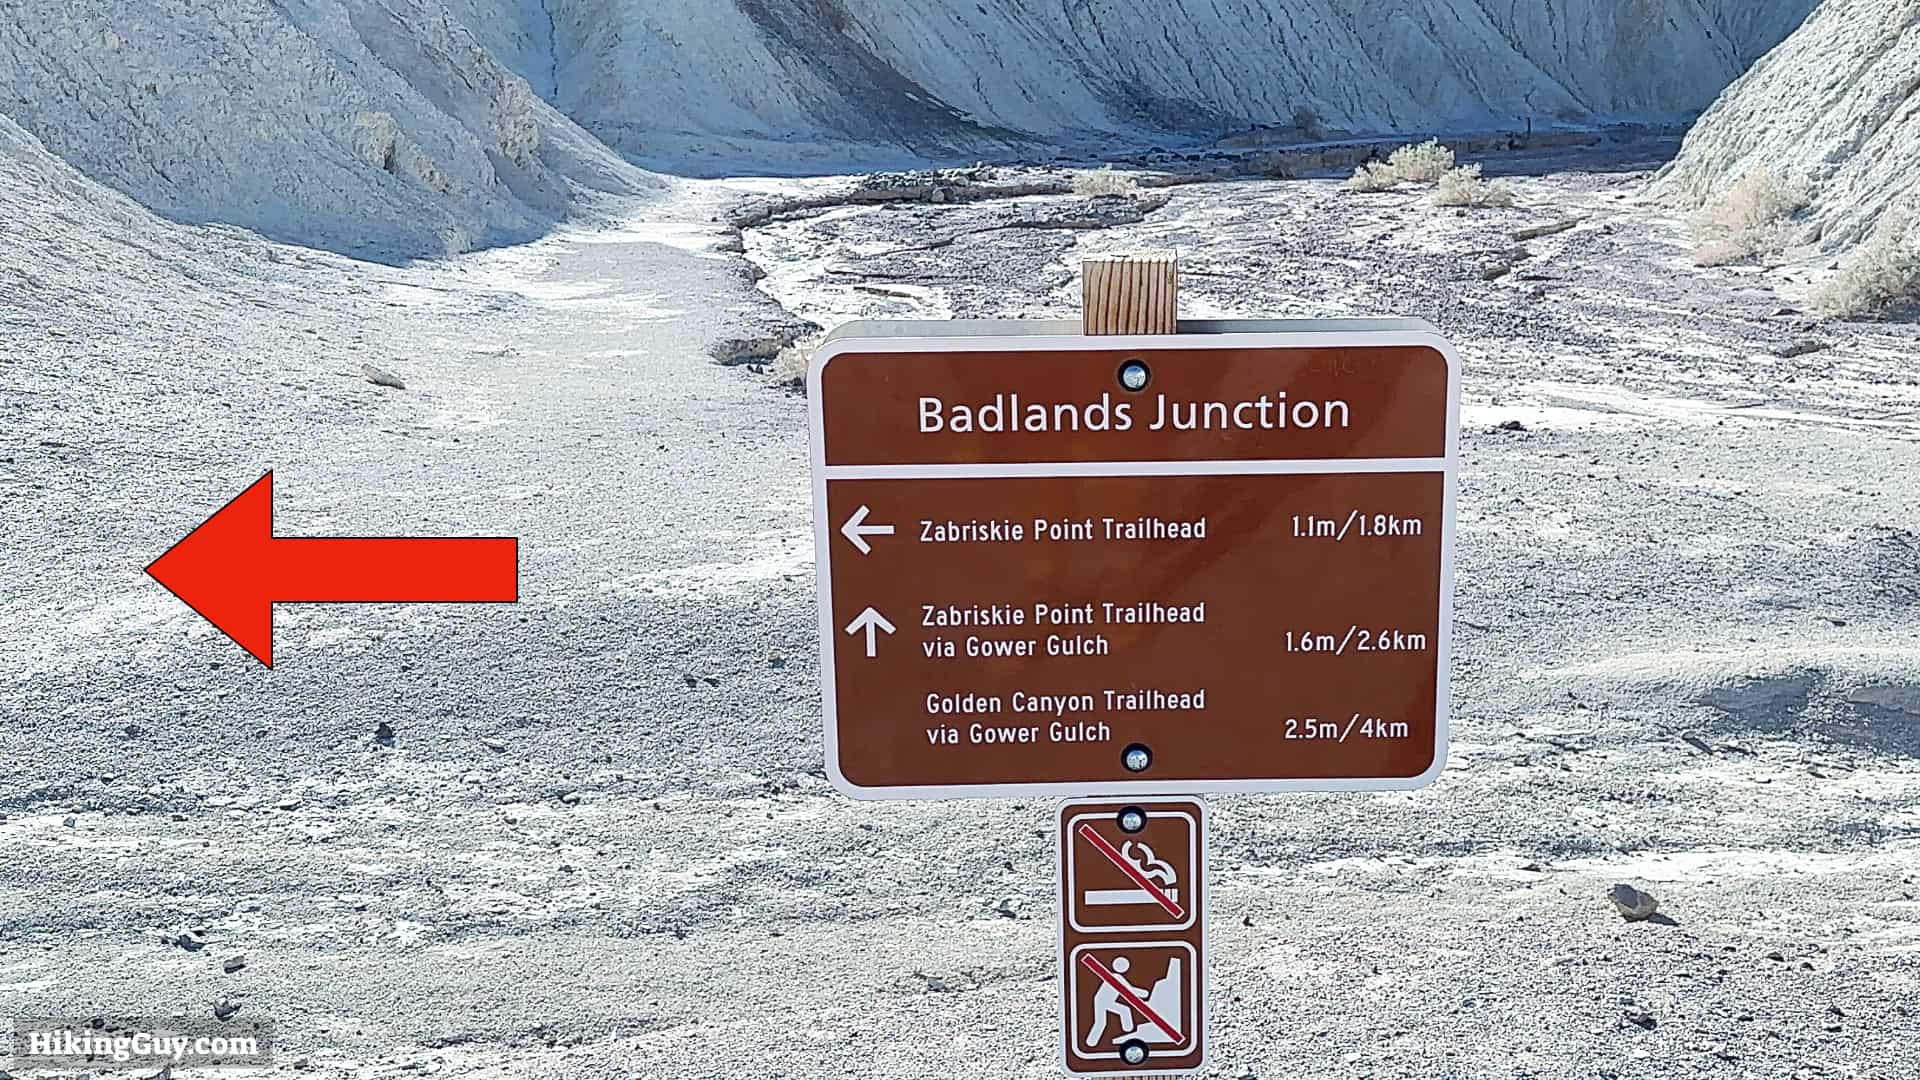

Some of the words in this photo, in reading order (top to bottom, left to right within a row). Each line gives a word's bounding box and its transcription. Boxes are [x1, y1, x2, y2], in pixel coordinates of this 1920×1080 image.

[920, 393, 1131, 432] Badlands
[1149, 392, 1349, 430] Junction
[920, 519, 1024, 542] Zabriskie
[1034, 518, 1093, 541] Point
[1102, 517, 1206, 540] Trailhead
[1292, 510, 1422, 541] 1.1m/1.8km
[922, 604, 1025, 626] Zabriskie
[1035, 603, 1094, 625] Point
[1102, 601, 1205, 624] Trailhead
[922, 636, 955, 658] via
[966, 636, 1037, 657] Gower
[1047, 634, 1108, 656] Gulch
[1286, 625, 1426, 656] 1.6m/2.6km
[926, 692, 1001, 714] Golden
[1012, 691, 1094, 717] Canyon
[1103, 688, 1205, 711] Trailhead
[926, 723, 959, 745] via
[969, 723, 1040, 744] Gower
[1049, 721, 1110, 742] Gulch
[1285, 713, 1408, 743] 2.5m/4km
